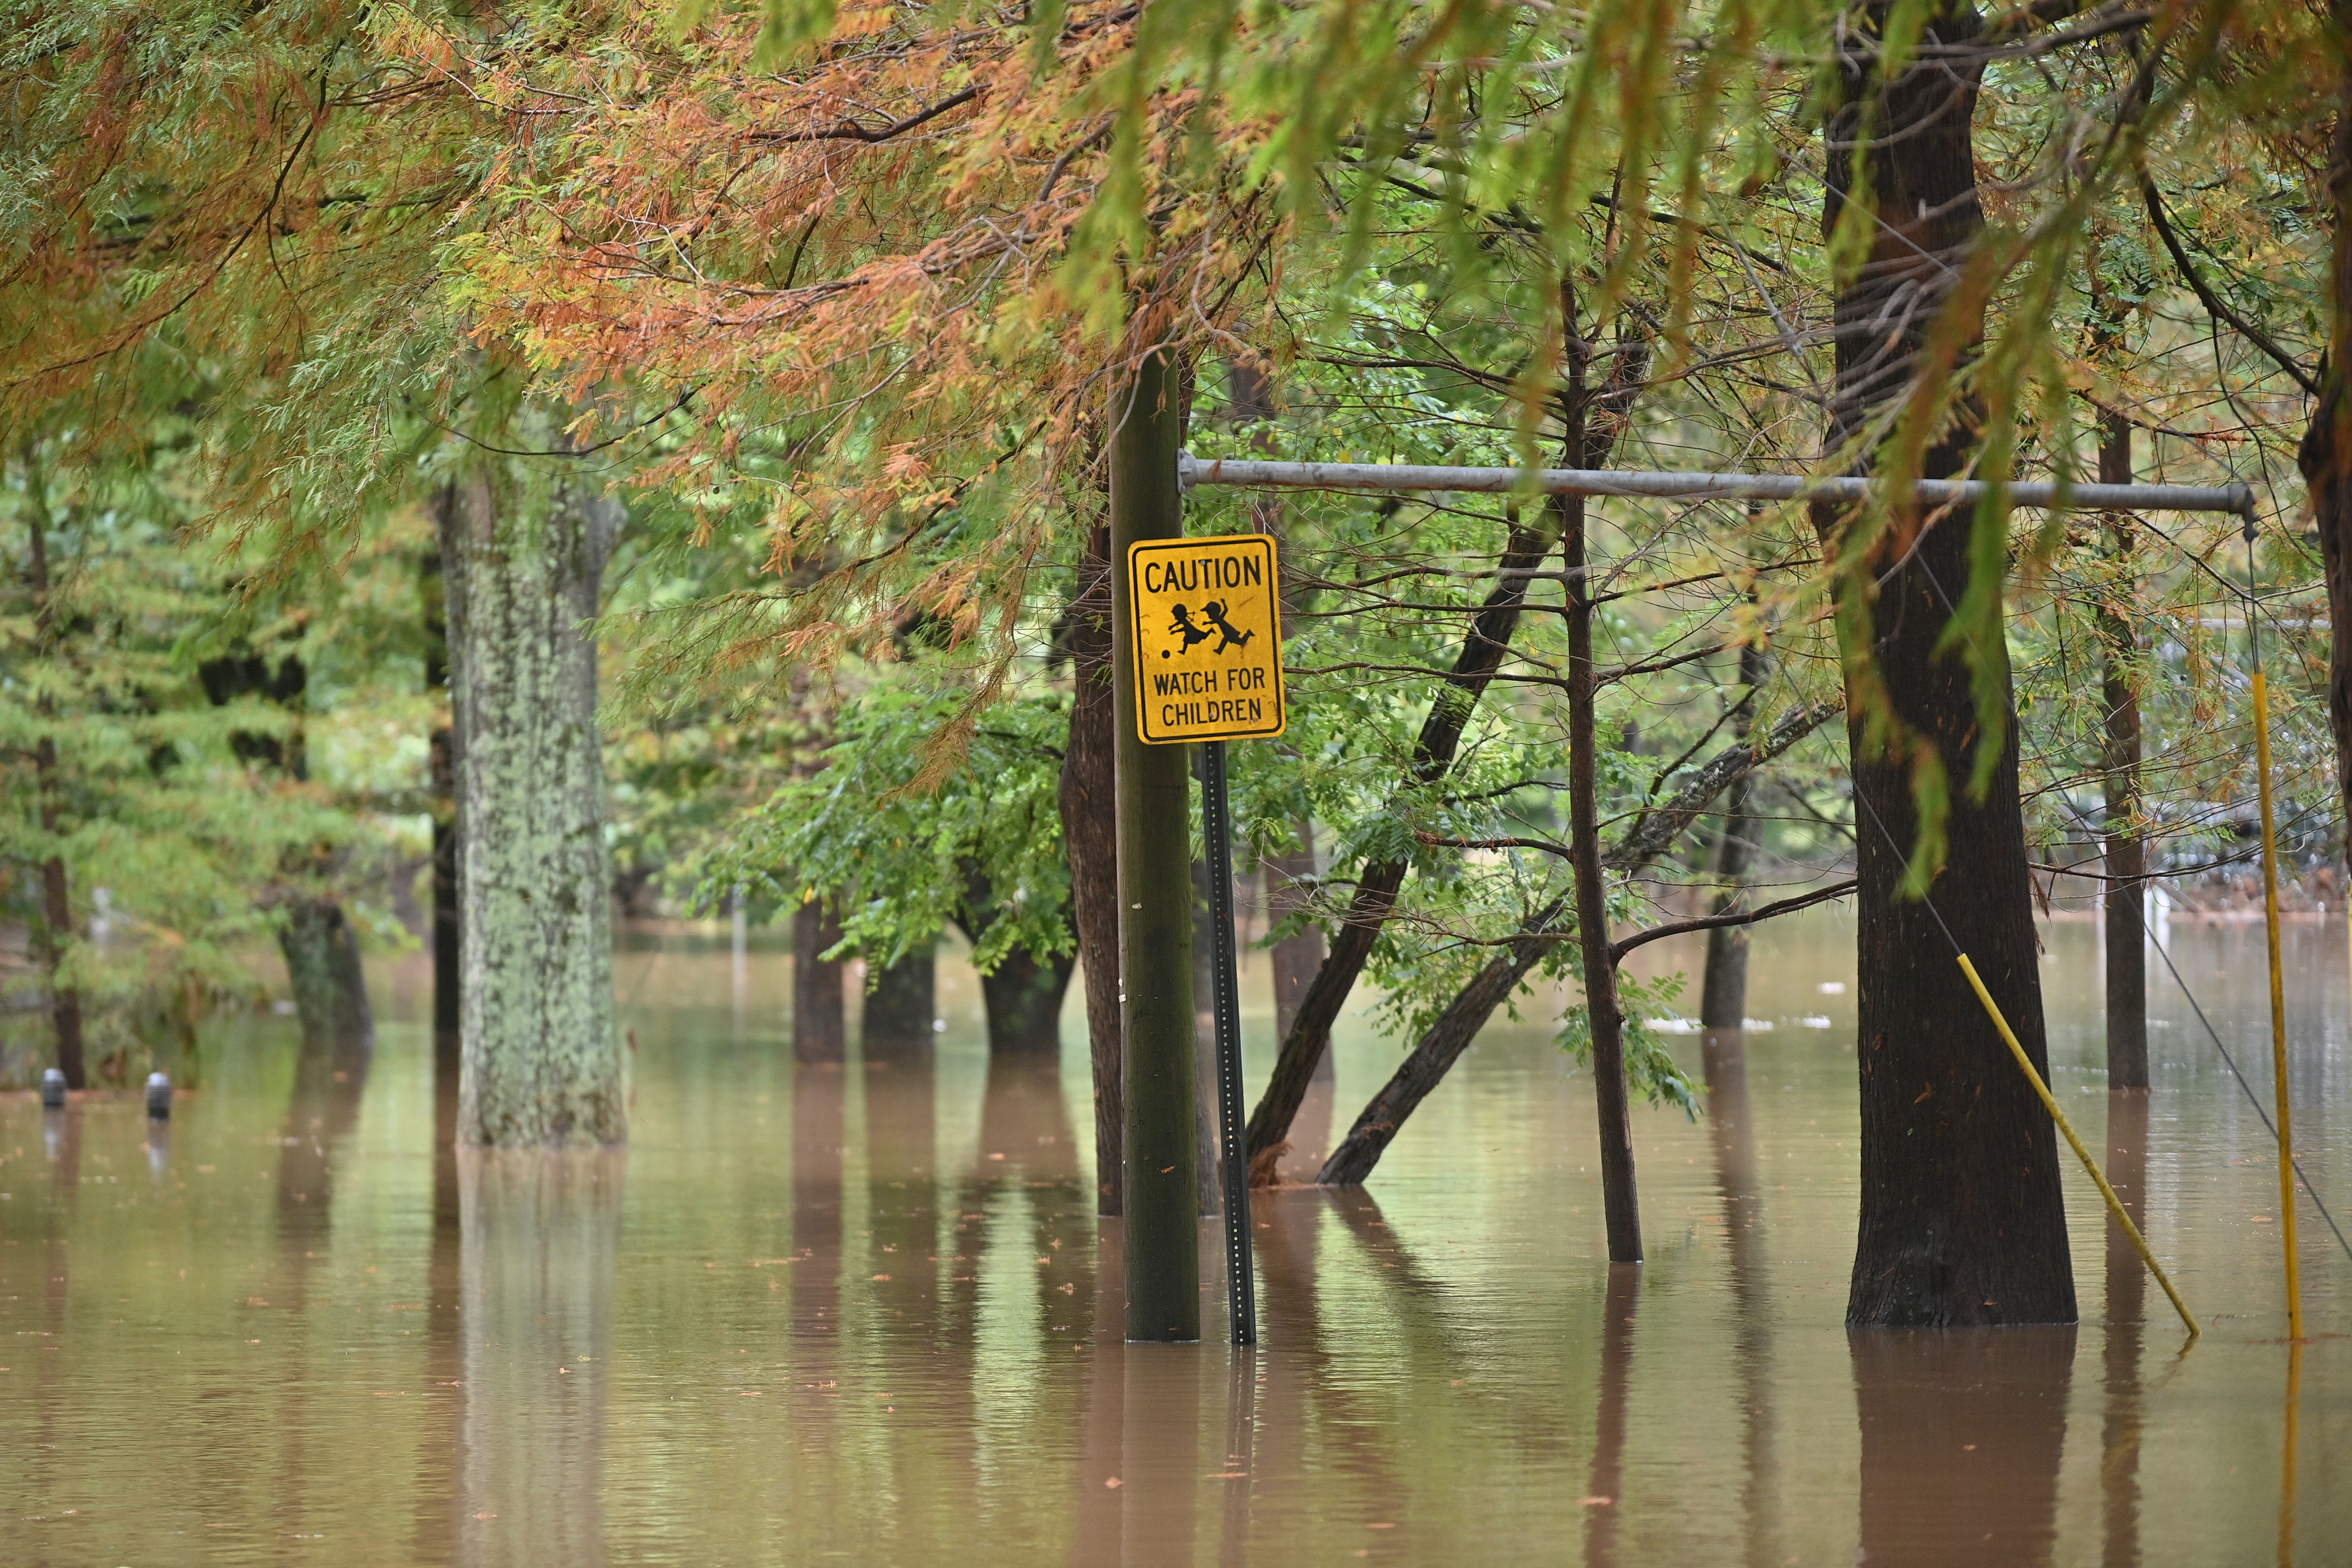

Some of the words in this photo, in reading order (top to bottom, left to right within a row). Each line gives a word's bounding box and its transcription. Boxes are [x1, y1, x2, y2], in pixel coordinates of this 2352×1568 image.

[1145, 555, 1261, 593] CAUTION
[1154, 670, 1217, 696] WATCH
[1228, 667, 1265, 691] FOR
[1162, 698, 1262, 727] CHILDREN
